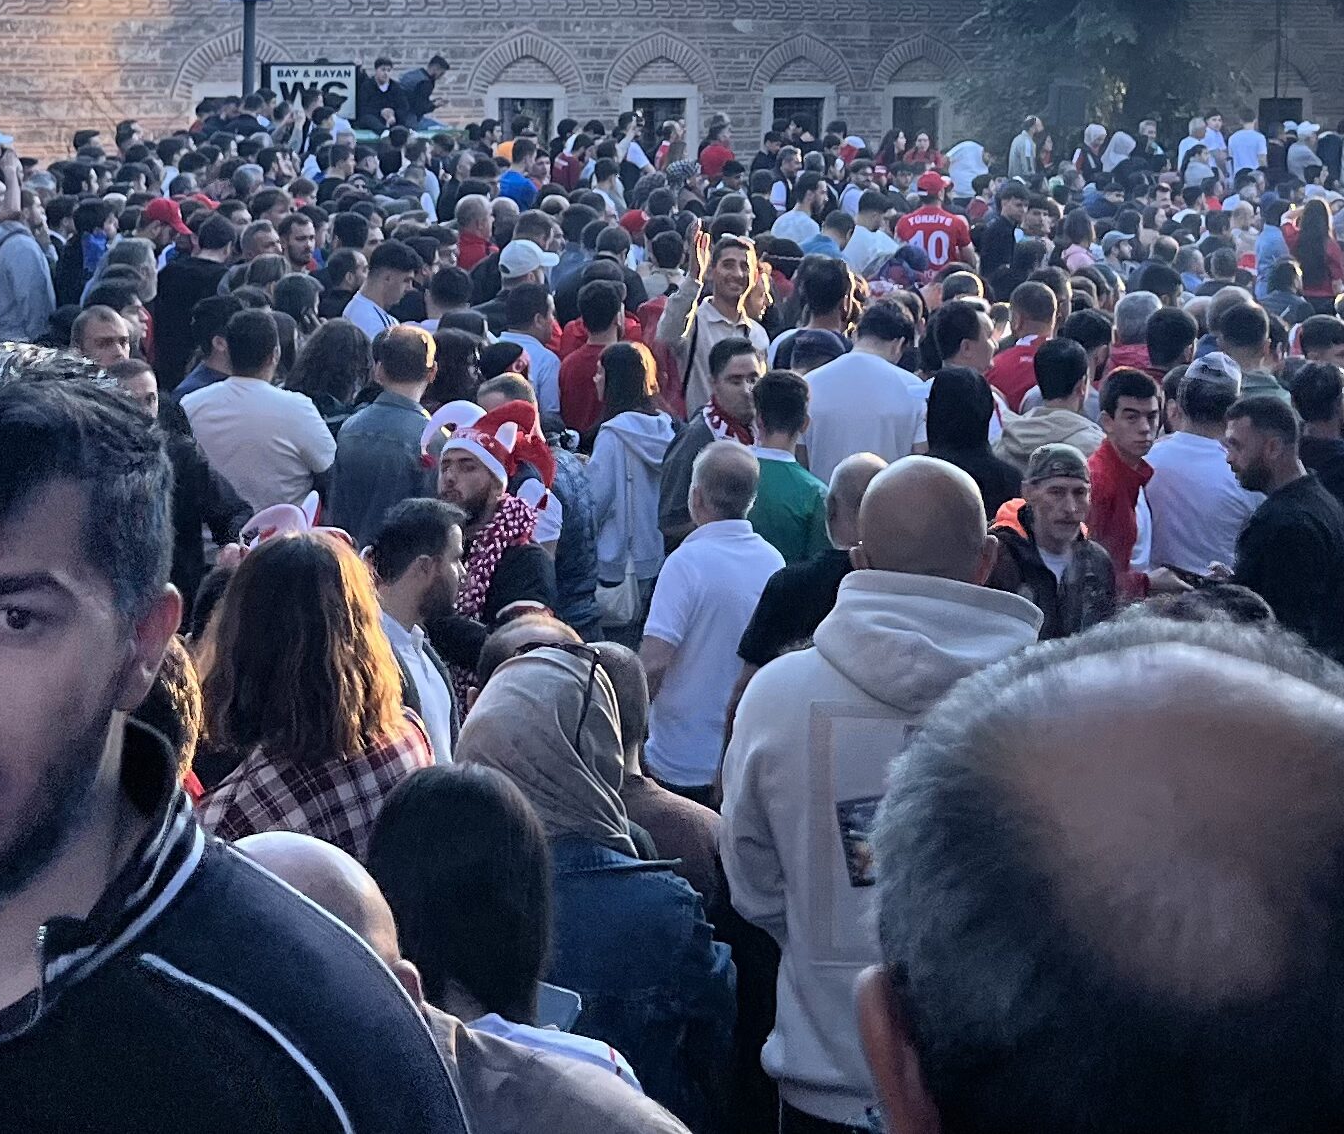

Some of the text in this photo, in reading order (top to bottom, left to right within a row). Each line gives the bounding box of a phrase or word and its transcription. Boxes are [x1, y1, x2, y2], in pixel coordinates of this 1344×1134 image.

[277, 69, 298, 78] BAY
[315, 69, 351, 78] BAYAN
[908, 229, 950, 266] 10
